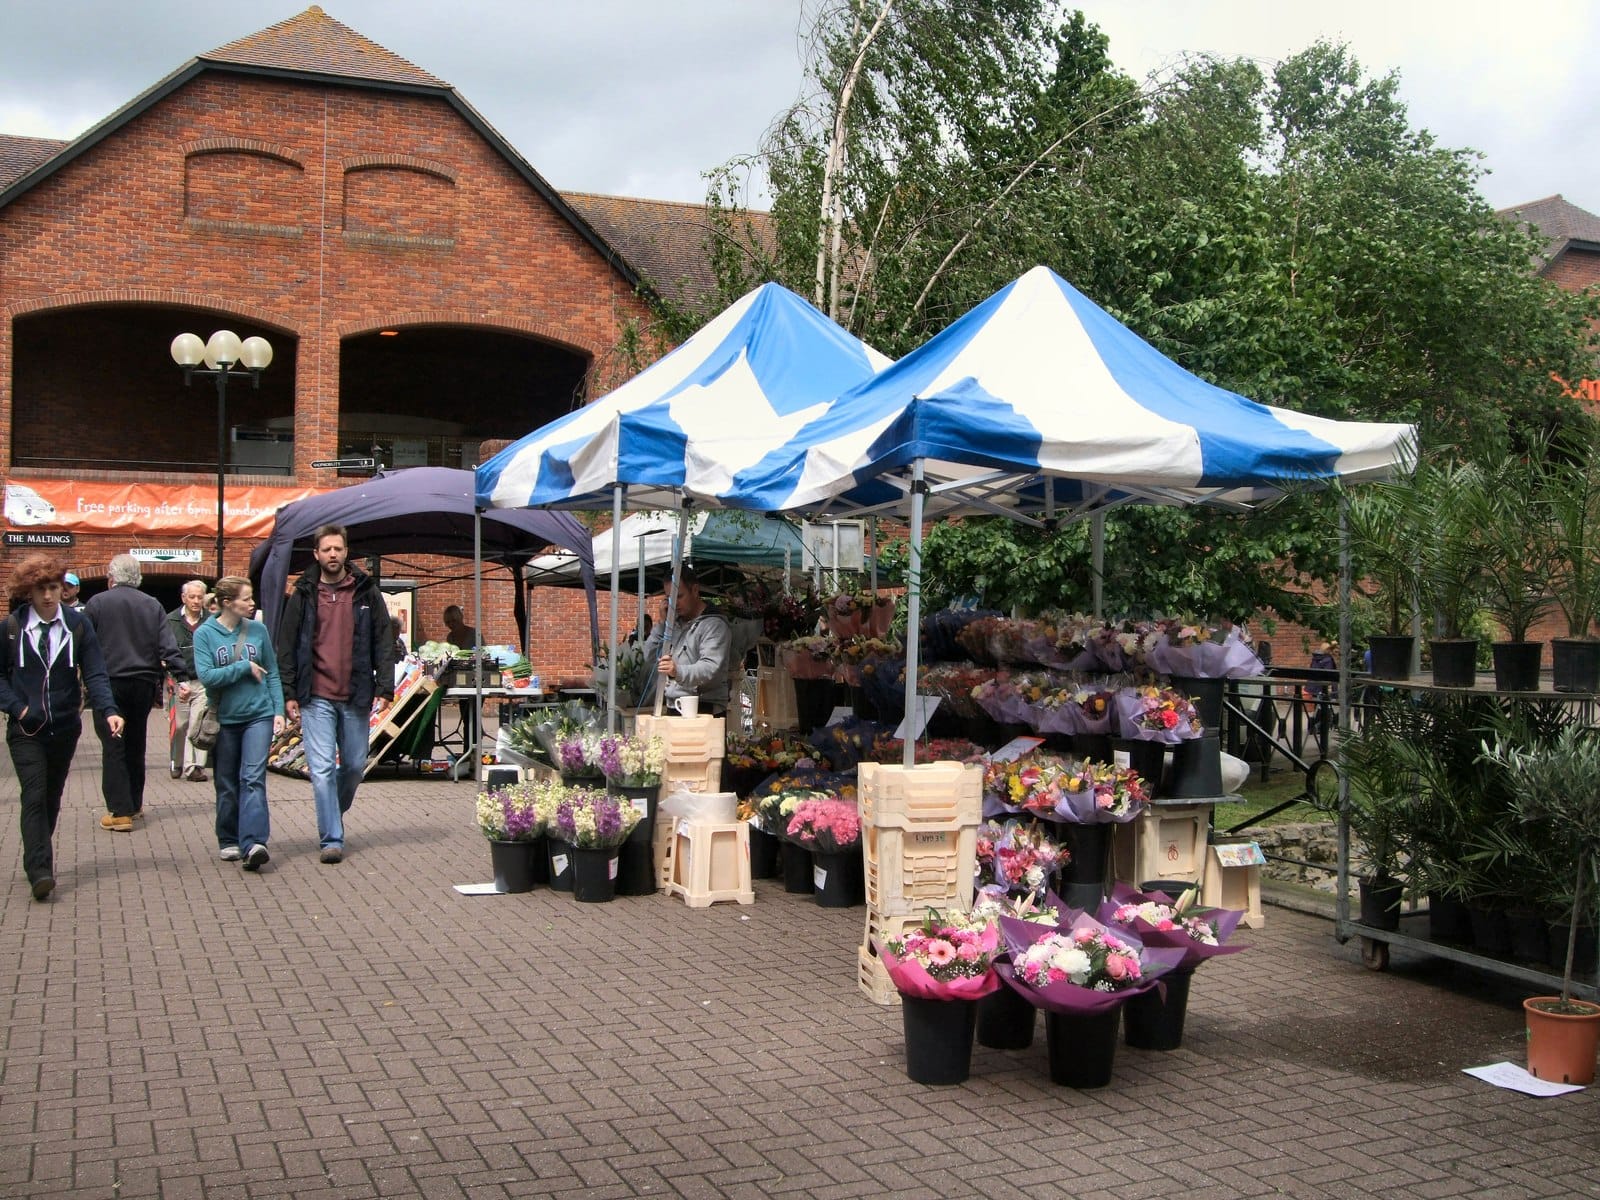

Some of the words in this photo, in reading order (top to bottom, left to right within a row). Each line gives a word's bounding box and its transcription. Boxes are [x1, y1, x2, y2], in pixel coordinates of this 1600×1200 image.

[77, 497, 105, 513] Free
[108, 501, 151, 518] parking
[154, 501, 183, 516] after
[187, 502, 212, 517] 6pm
[7, 534, 24, 543] THE
[27, 534, 71, 544] MALTINGS
[131, 549, 197, 557] SHOPMOBILITY
